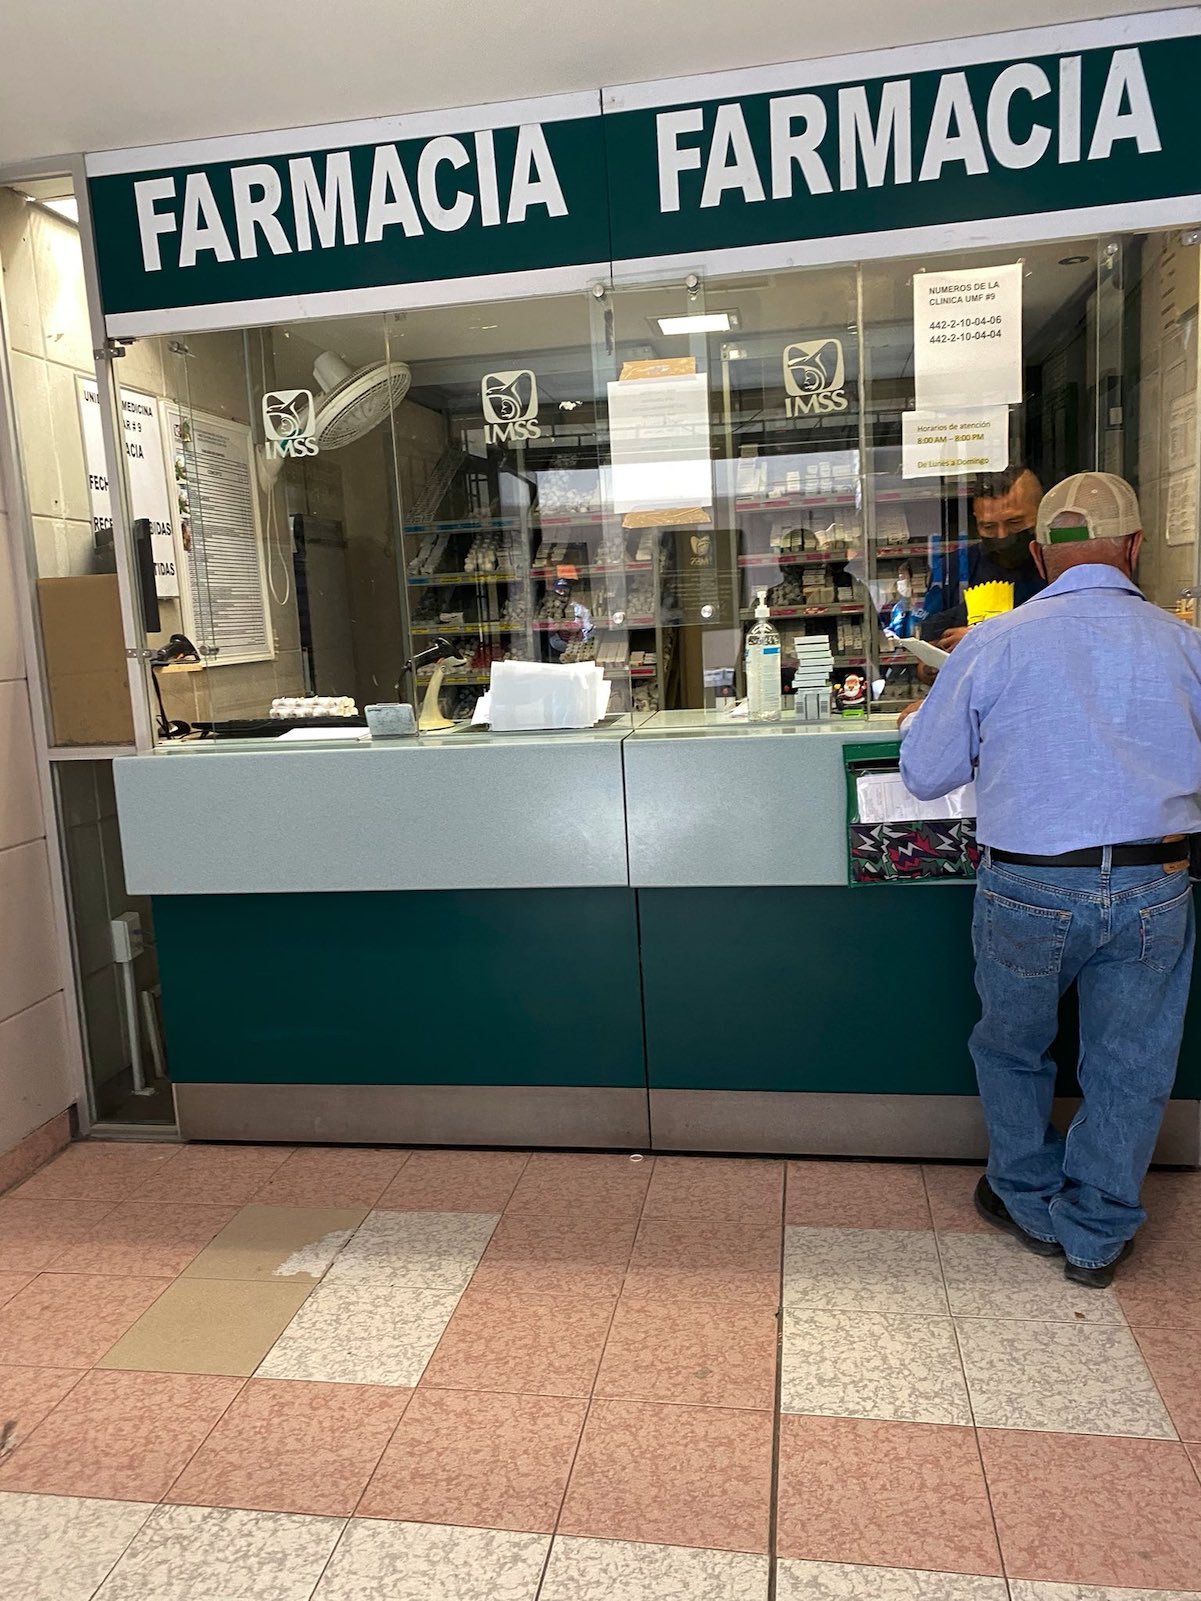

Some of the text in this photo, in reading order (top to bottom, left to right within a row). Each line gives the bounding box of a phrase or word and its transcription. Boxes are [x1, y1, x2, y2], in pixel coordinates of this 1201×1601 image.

[656, 47, 1162, 213] FARMACIA
[133, 123, 568, 272] FARMACIA
[929, 281, 1000, 295] NUMEROS DE LA
[929, 292, 996, 306] CLINICA UMF #9
[929, 315, 1002, 330] 442-2-10-04-06
[929, 329, 1002, 344] 442-2-10-04-04
[121, 400, 153, 417] MEDICINA
[785, 389, 849, 418] IMSS
[484, 419, 541, 444] IMSS
[917, 420, 991, 432] Horarios de atención
[954, 434, 971, 442] 8:00
[265, 437, 319, 460] IMSS
[929, 459, 950, 468] Lunes
[957, 457, 989, 466] Domingo
